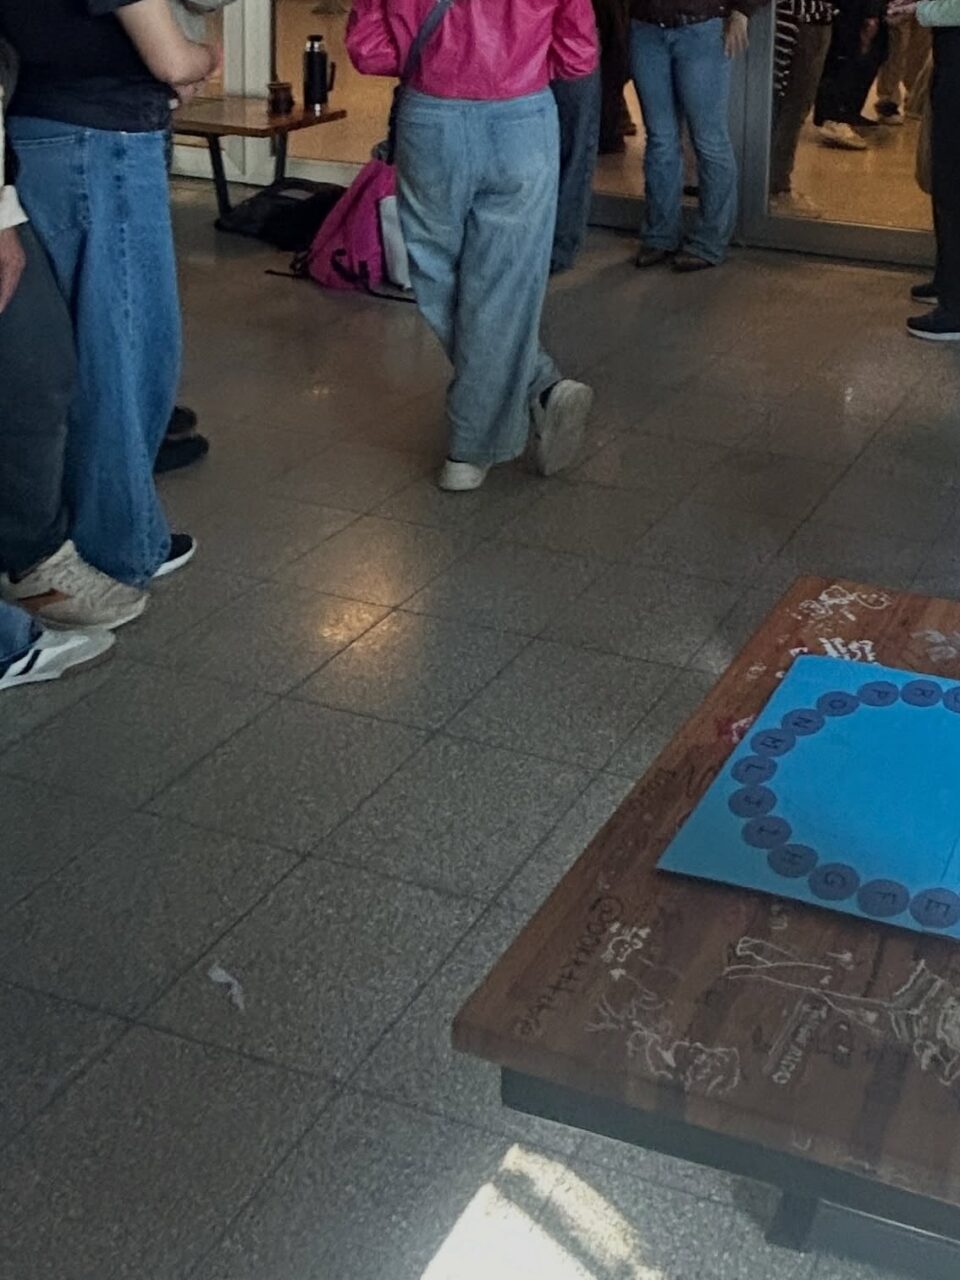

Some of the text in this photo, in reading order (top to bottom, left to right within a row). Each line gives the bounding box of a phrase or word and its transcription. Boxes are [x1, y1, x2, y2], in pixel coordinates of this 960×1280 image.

[873, 688, 889, 699] P
[914, 687, 932, 697] R
[829, 699, 846, 709] O
[793, 717, 812, 728] N
[824, 872, 846, 887] G
[878, 892, 896, 904] F
[925, 899, 950, 917] E
